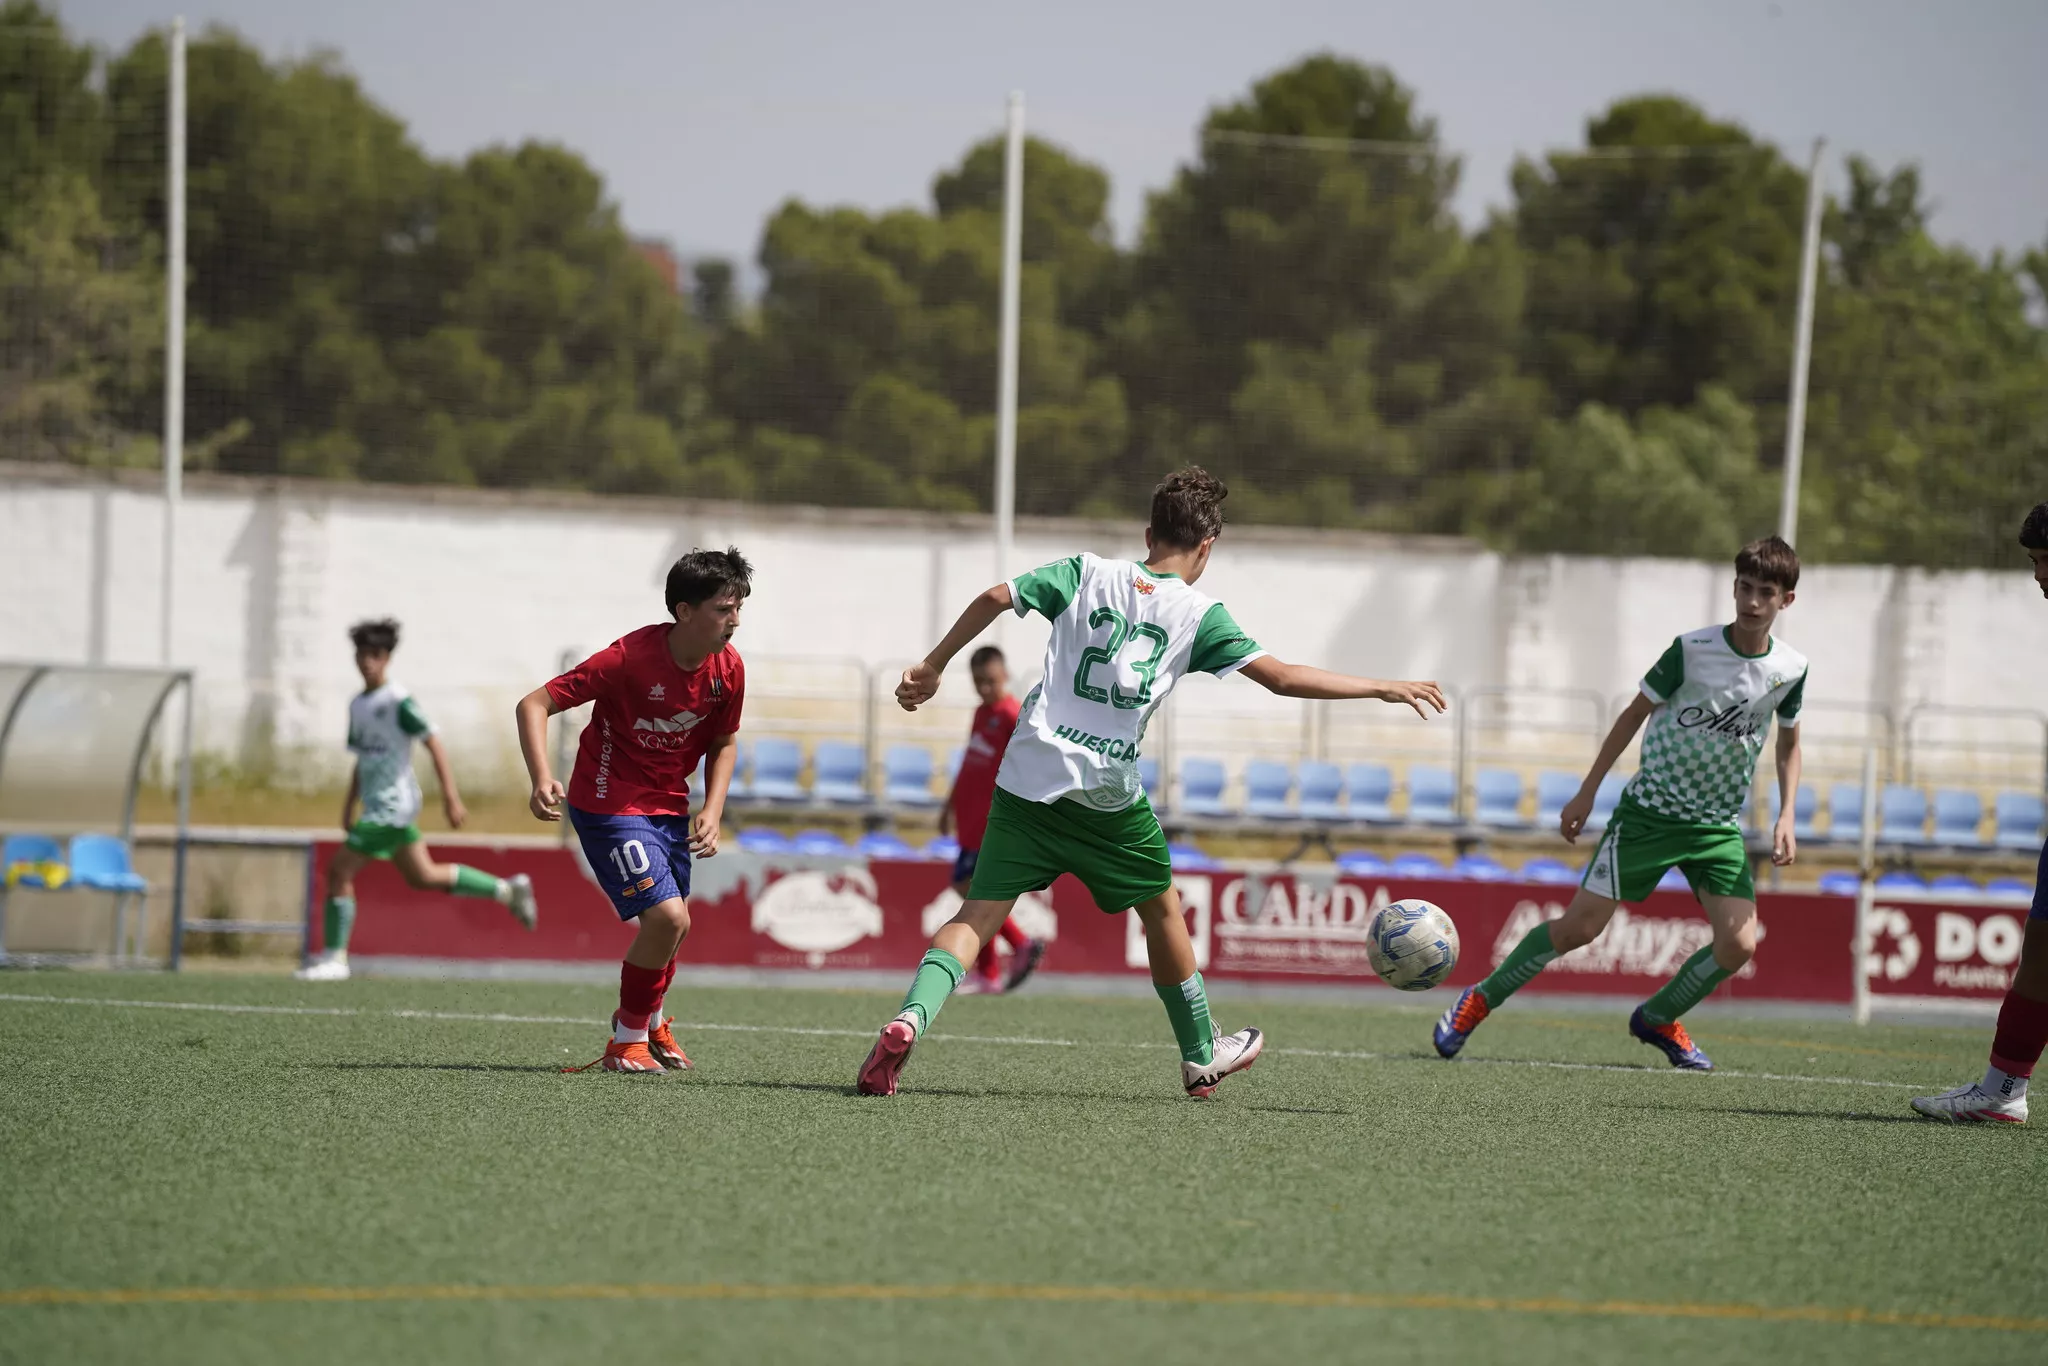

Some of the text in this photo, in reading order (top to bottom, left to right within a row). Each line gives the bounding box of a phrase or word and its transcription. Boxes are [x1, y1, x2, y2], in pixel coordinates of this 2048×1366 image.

[1073, 606, 1169, 710] 23
[1052, 724, 1136, 763] HUESCA
[609, 839, 650, 882] 10
